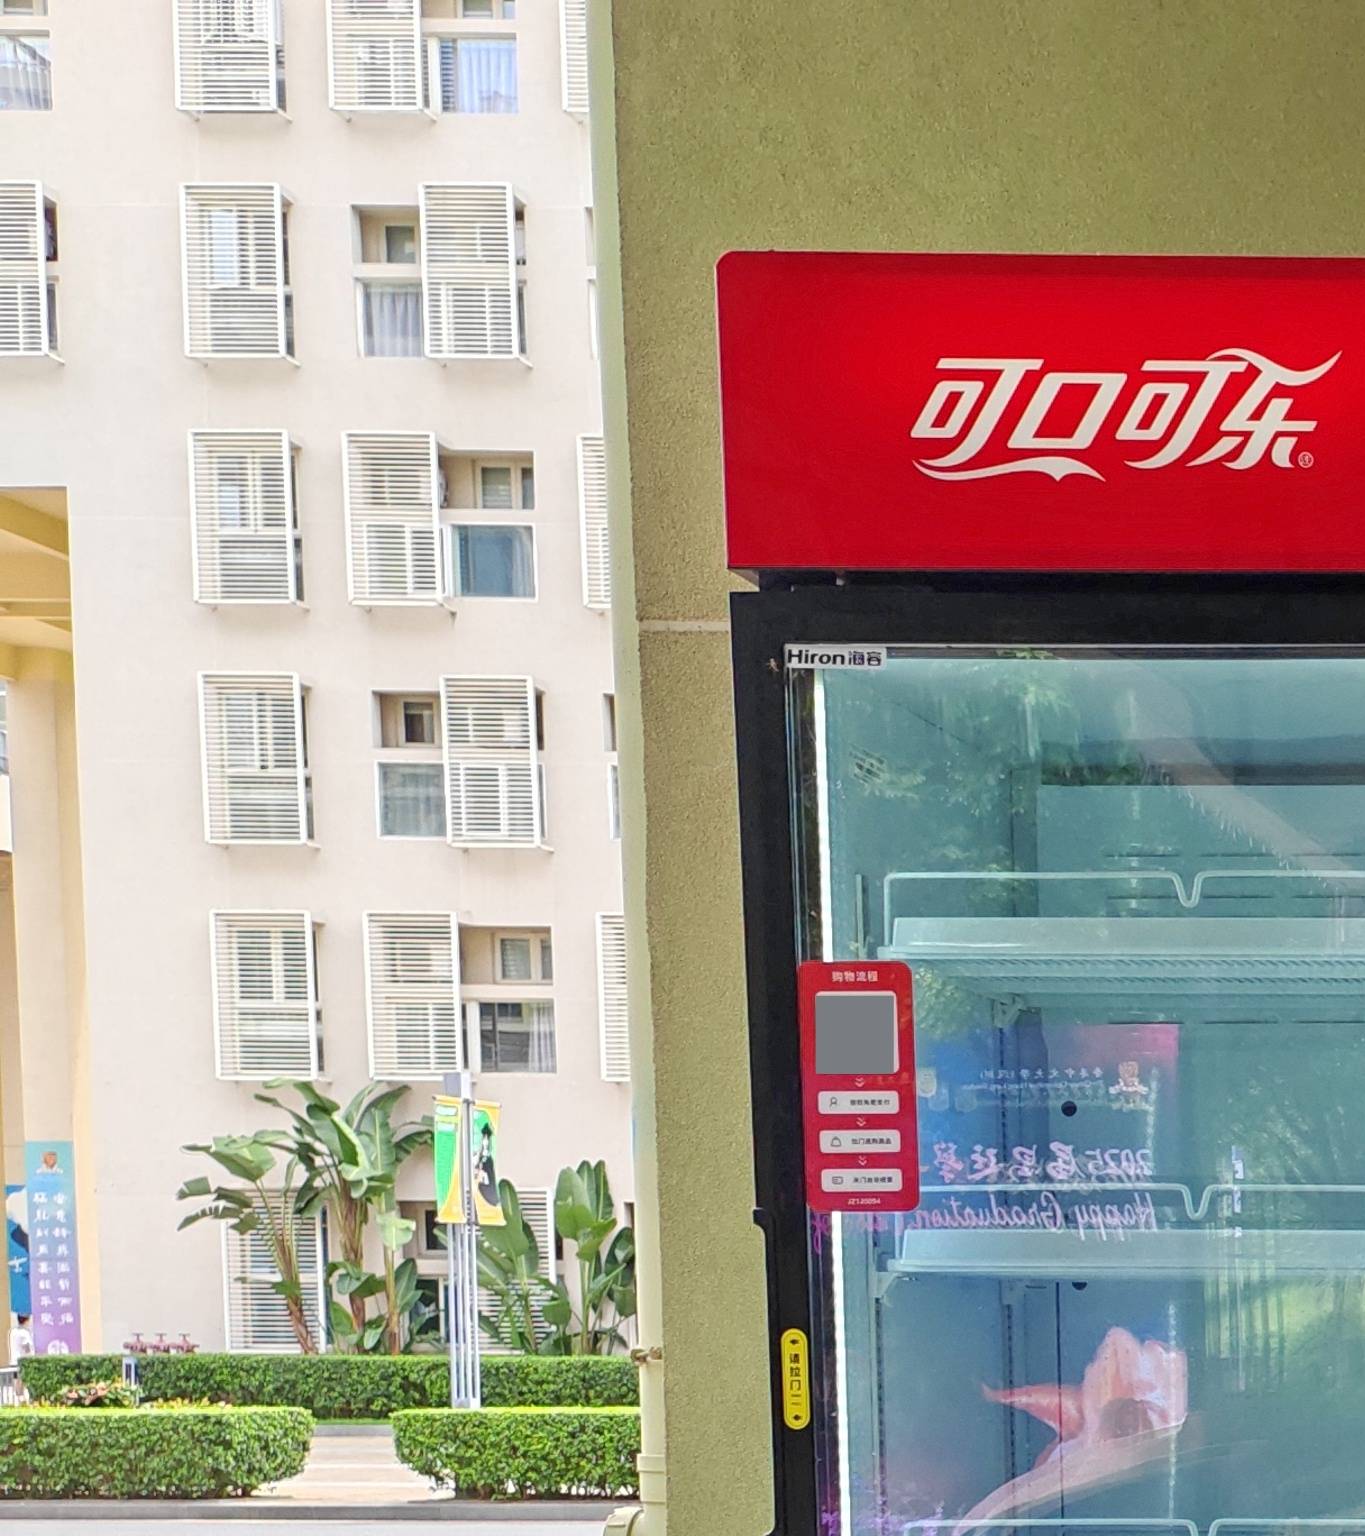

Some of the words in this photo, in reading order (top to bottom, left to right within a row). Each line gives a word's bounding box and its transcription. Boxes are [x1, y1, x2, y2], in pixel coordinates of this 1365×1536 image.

[911, 347, 1342, 482] 可口可乐
[786, 648, 845, 665] Hiron
[831, 970, 879, 983] 购物流程
